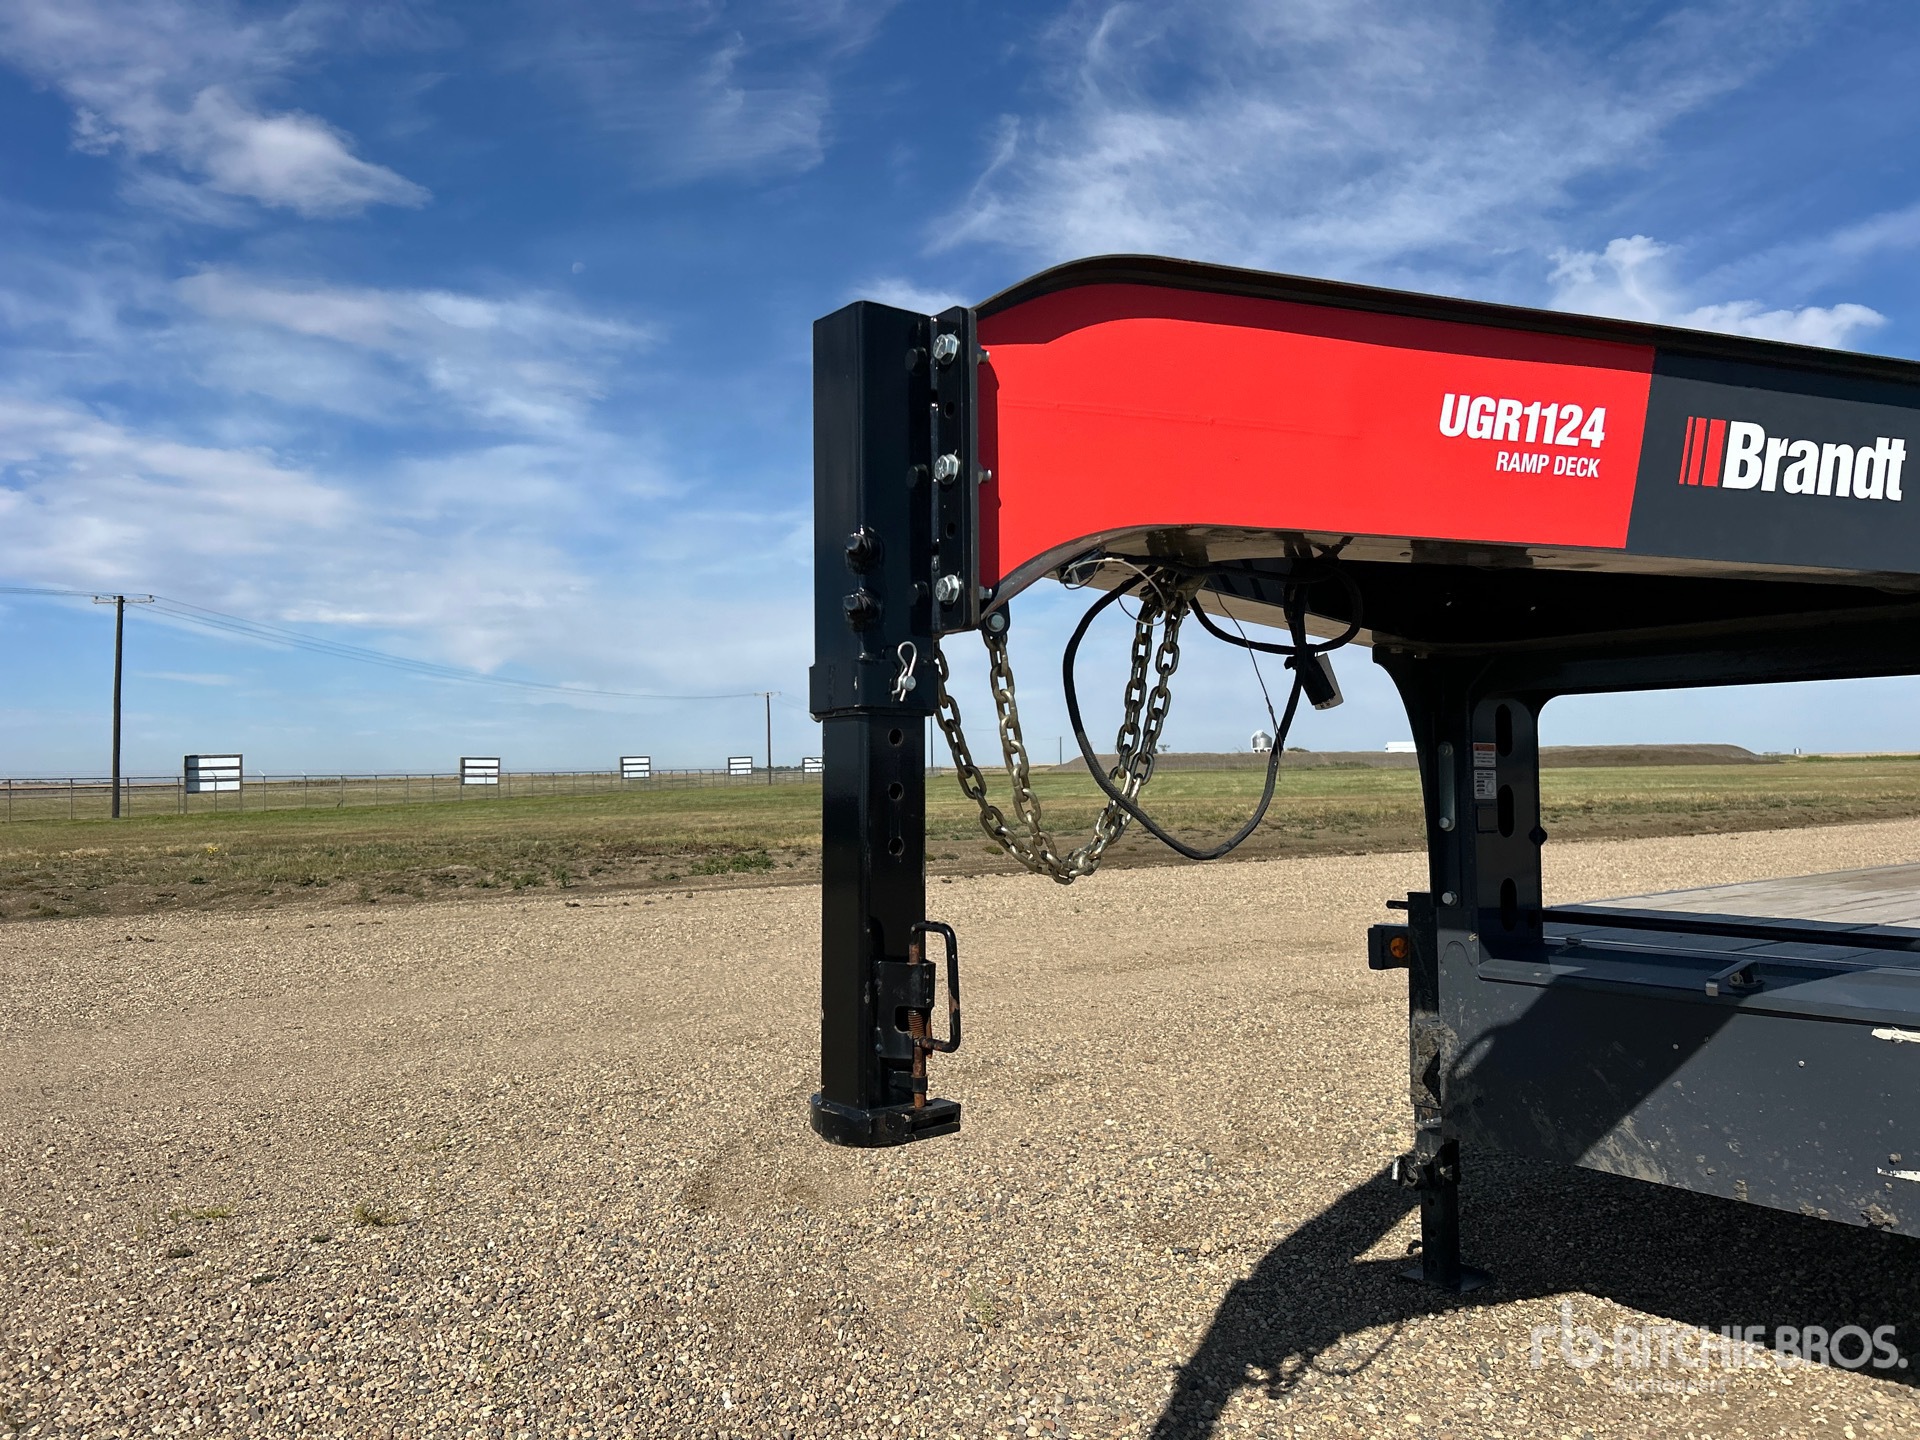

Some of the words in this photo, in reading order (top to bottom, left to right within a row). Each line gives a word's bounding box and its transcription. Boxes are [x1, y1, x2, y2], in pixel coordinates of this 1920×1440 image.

[1438, 393, 1607, 448] UGR1124
[1495, 451, 1550, 474] RAMP
[1553, 455, 1601, 478] DECK
[1721, 420, 1907, 502] Brandt
